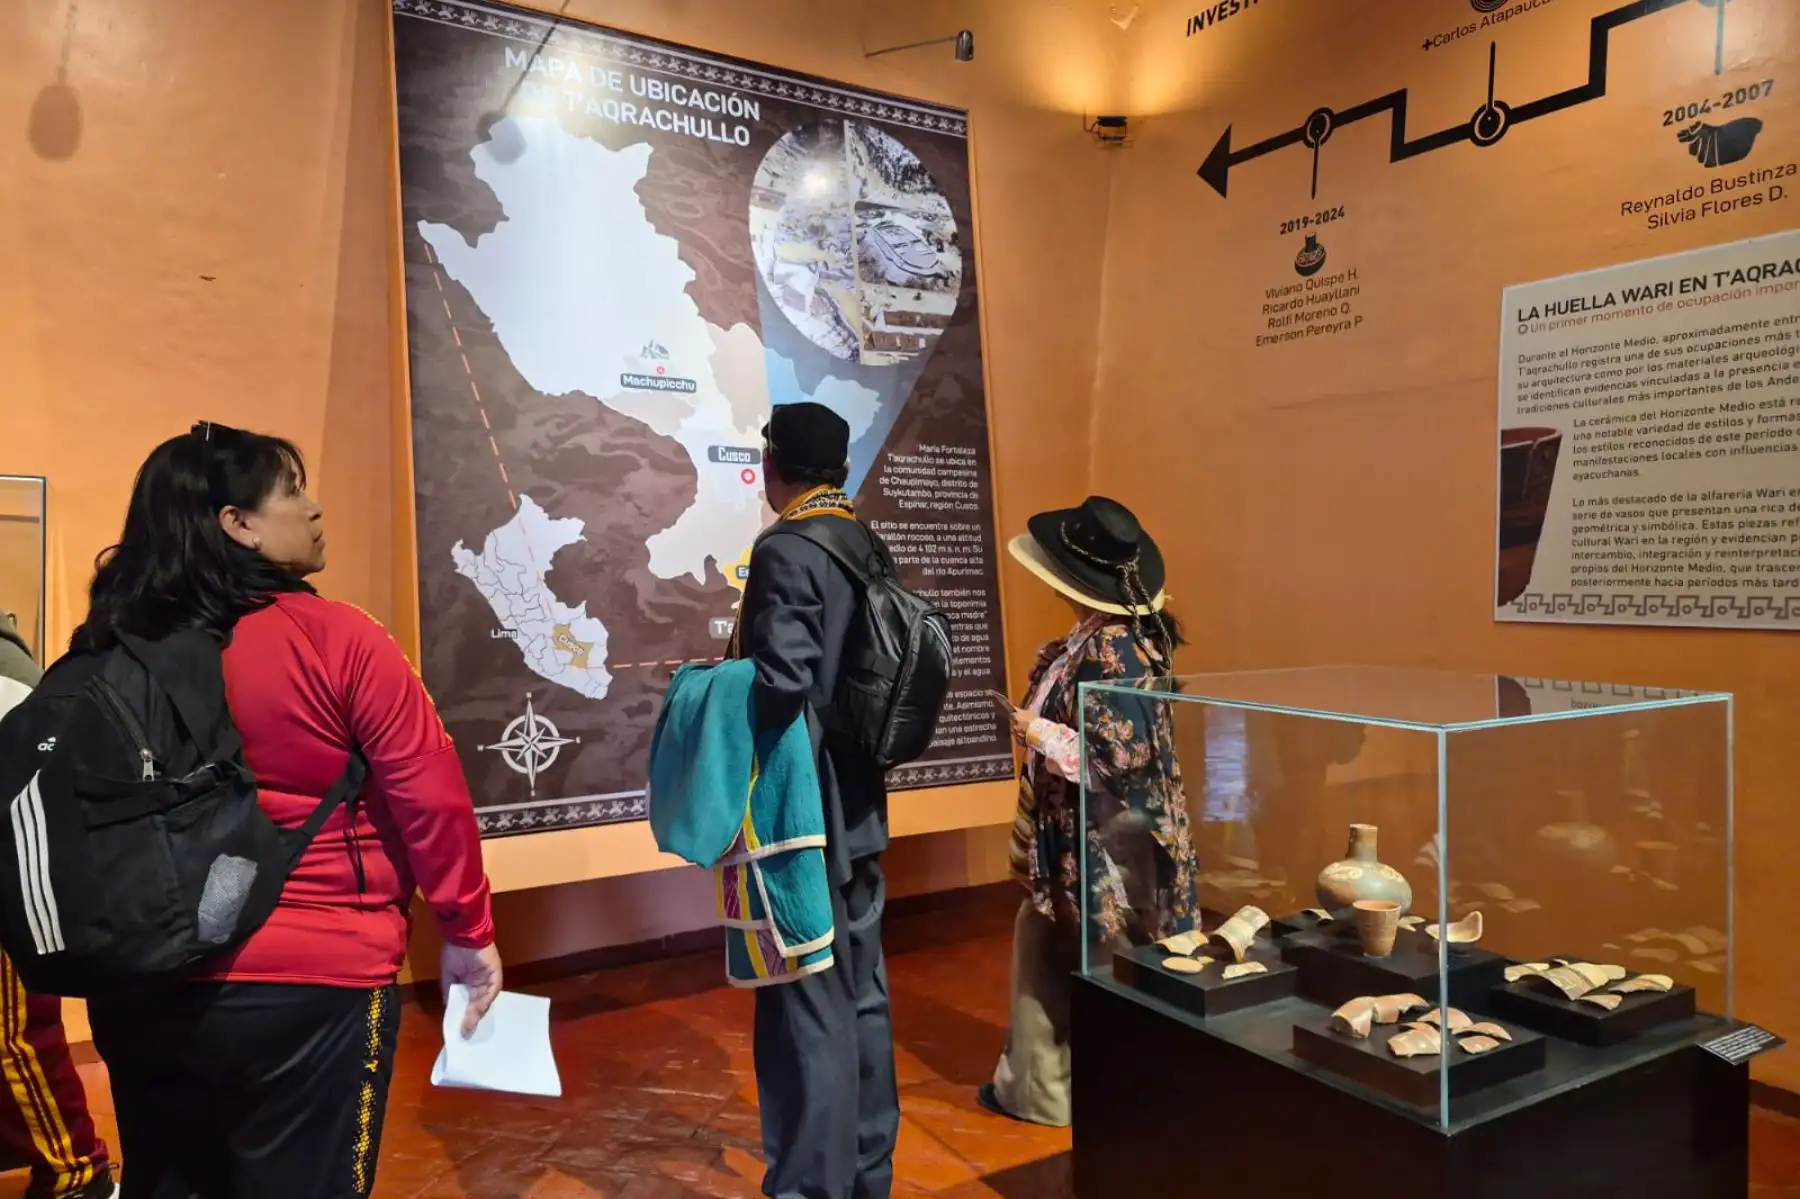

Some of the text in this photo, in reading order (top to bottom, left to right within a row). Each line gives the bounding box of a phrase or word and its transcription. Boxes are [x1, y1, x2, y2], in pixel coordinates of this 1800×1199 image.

[1186, 0, 1259, 37] INVES
[504, 46, 760, 121] MAPA DE UBICACIÓN
[1662, 79, 1774, 127] 2004-2007
[1620, 162, 1797, 217] Reynaldo Bustinza
[1279, 204, 1345, 235] 2019-2024
[1647, 185, 1788, 230] Silvia Flores D.
[1262, 284, 1360, 315] Ricardo Huayllani
[1264, 283, 1303, 300] Viviano
[1305, 273, 1345, 290] Quispe
[1517, 305, 1540, 323] LA
[1544, 291, 1617, 319] HUELLA
[1621, 280, 1674, 305] WARI
[1679, 274, 1708, 295] EN
[1294, 307, 1338, 324] Moreno
[1530, 323, 1546, 333] Un
[1548, 315, 1589, 332] primer
[1591, 302, 1654, 324] momento
[1656, 300, 1674, 312] de
[1676, 287, 1752, 309] ocupación
[1255, 329, 1304, 347] Emerson
[1306, 319, 1352, 337] Pereyra
[1518, 350, 1557, 364] Durante
[1559, 347, 1568, 358] el
[1571, 341, 1621, 356] Horizonte
[1662, 319, 1770, 343] aproximadamente
[1581, 355, 1621, 369] registra
[1624, 352, 1644, 362] una
[1647, 347, 1660, 359] de
[1663, 346, 1683, 356] sus
[1686, 335, 1761, 355] ocupaciones
[1764, 330, 1792, 343] más
[622, 374, 696, 392] Machupicchu
[1517, 380, 1529, 391] su
[1531, 372, 1592, 389] arquitectura
[1594, 367, 1623, 380] como
[1626, 364, 1645, 378] por
[1647, 361, 1663, 373] los
[1666, 354, 1729, 370] materiales
[1517, 360, 1790, 402] se identifican evidencias vinculadas a la presencia
[1517, 401, 1570, 414] tradiciones
[1572, 394, 1624, 409] culturales
[1627, 390, 1651, 402] más
[1654, 383, 1724, 400] importantes
[1727, 379, 1742, 391] de
[1745, 378, 1764, 390] los
[1573, 396, 1786, 428] La cerámica del Horizonte Medio está
[1573, 431, 1592, 441] una
[1595, 427, 1633, 439] notable
[1636, 420, 1684, 435] variedad
[1687, 420, 1701, 431] de
[1704, 417, 1744, 429] estilos
[1747, 417, 1754, 428] y
[717, 446, 751, 463] Cusco
[1573, 443, 1588, 454] los
[1591, 441, 1625, 453] estilos
[1628, 436, 1696, 450] reconocidos
[1698, 433, 1712, 444] de
[1716, 432, 1741, 443] este
[1573, 443, 1798, 468] manifestaciones locales con influencias
[1572, 497, 1585, 507] Lo
[1587, 495, 1609, 507] más
[1611, 492, 1667, 505] destacado
[1670, 491, 1684, 503] de
[1686, 490, 1698, 502] la
[1755, 487, 1786, 499] Wari
[1572, 503, 1785, 521] serie de vasos que presentan una rica
[1571, 523, 1630, 536] geométrica
[1632, 524, 1638, 534] y
[1702, 519, 1735, 530] Estas
[1738, 518, 1777, 531] piezas
[1571, 533, 1786, 547] cultural Wari en la región y evidencian
[1639, 548, 1702, 561] integración
[1705, 551, 1711, 560] y
[1571, 563, 1609, 575] propios
[1611, 563, 1628, 573] del
[1631, 563, 1684, 573] Horizonte
[1729, 563, 1752, 574] que
[1571, 577, 1652, 589] posteriormente
[1654, 577, 1684, 587] hacia
[1742, 577, 1768, 588] más
[490, 628, 518, 640] Lima
[558, 634, 585, 656] Cusco
